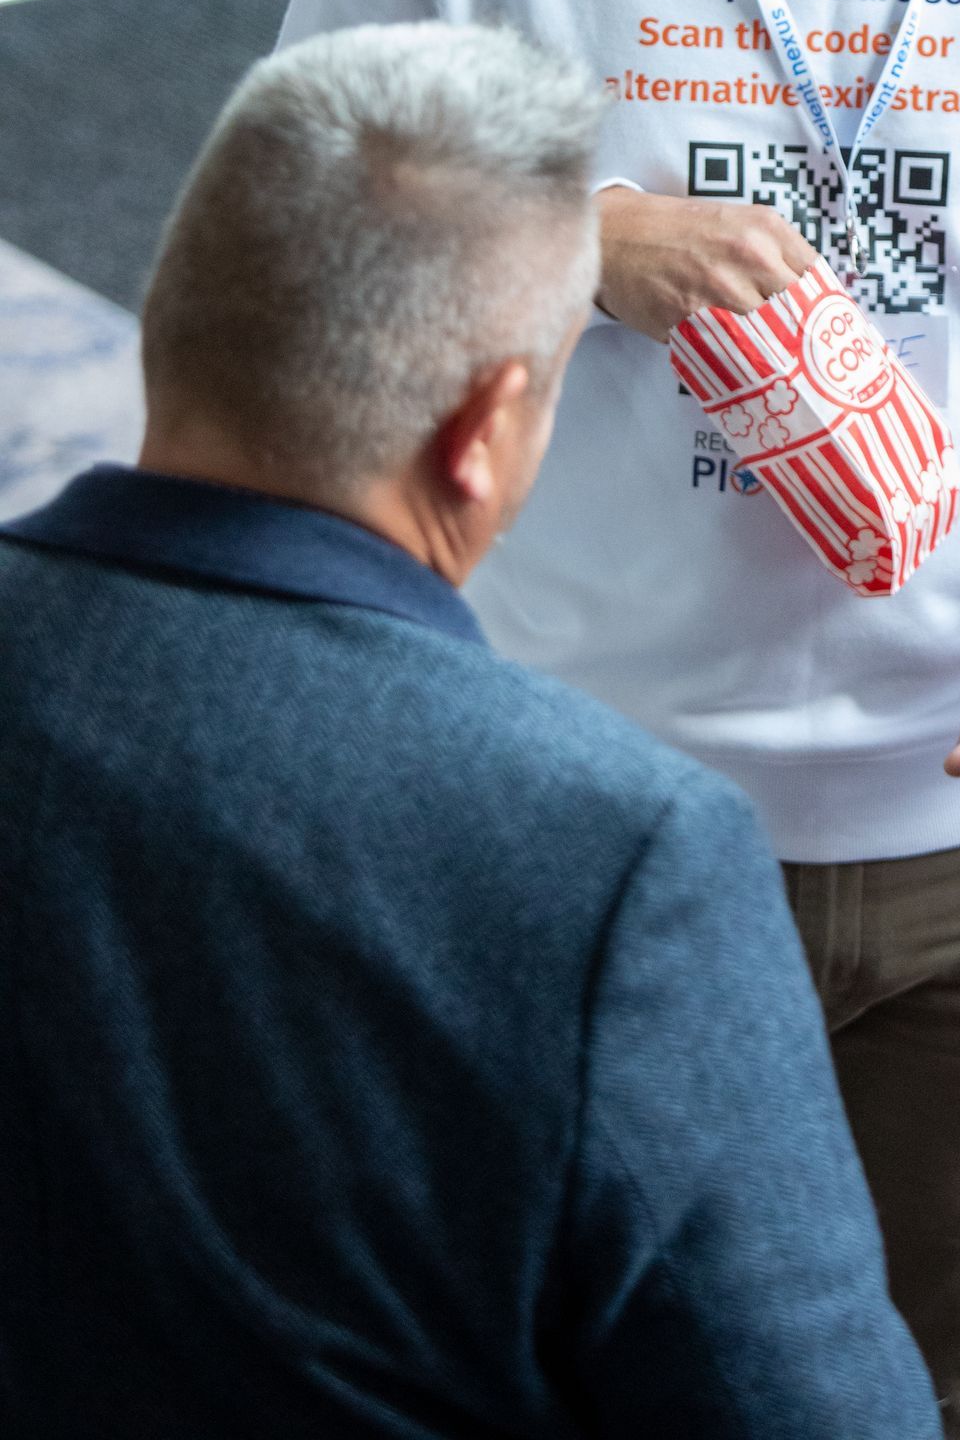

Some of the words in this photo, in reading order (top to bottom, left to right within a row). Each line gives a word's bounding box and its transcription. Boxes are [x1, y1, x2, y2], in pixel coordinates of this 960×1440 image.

[638, 16, 724, 48] Scan
[734, 19, 772, 51] th
[805, 23, 892, 56] code
[914, 33, 956, 59] or
[771, 7, 808, 77] nexus
[604, 69, 801, 107] alternative
[859, 81, 897, 143] alent
[819, 311, 855, 350] POP
